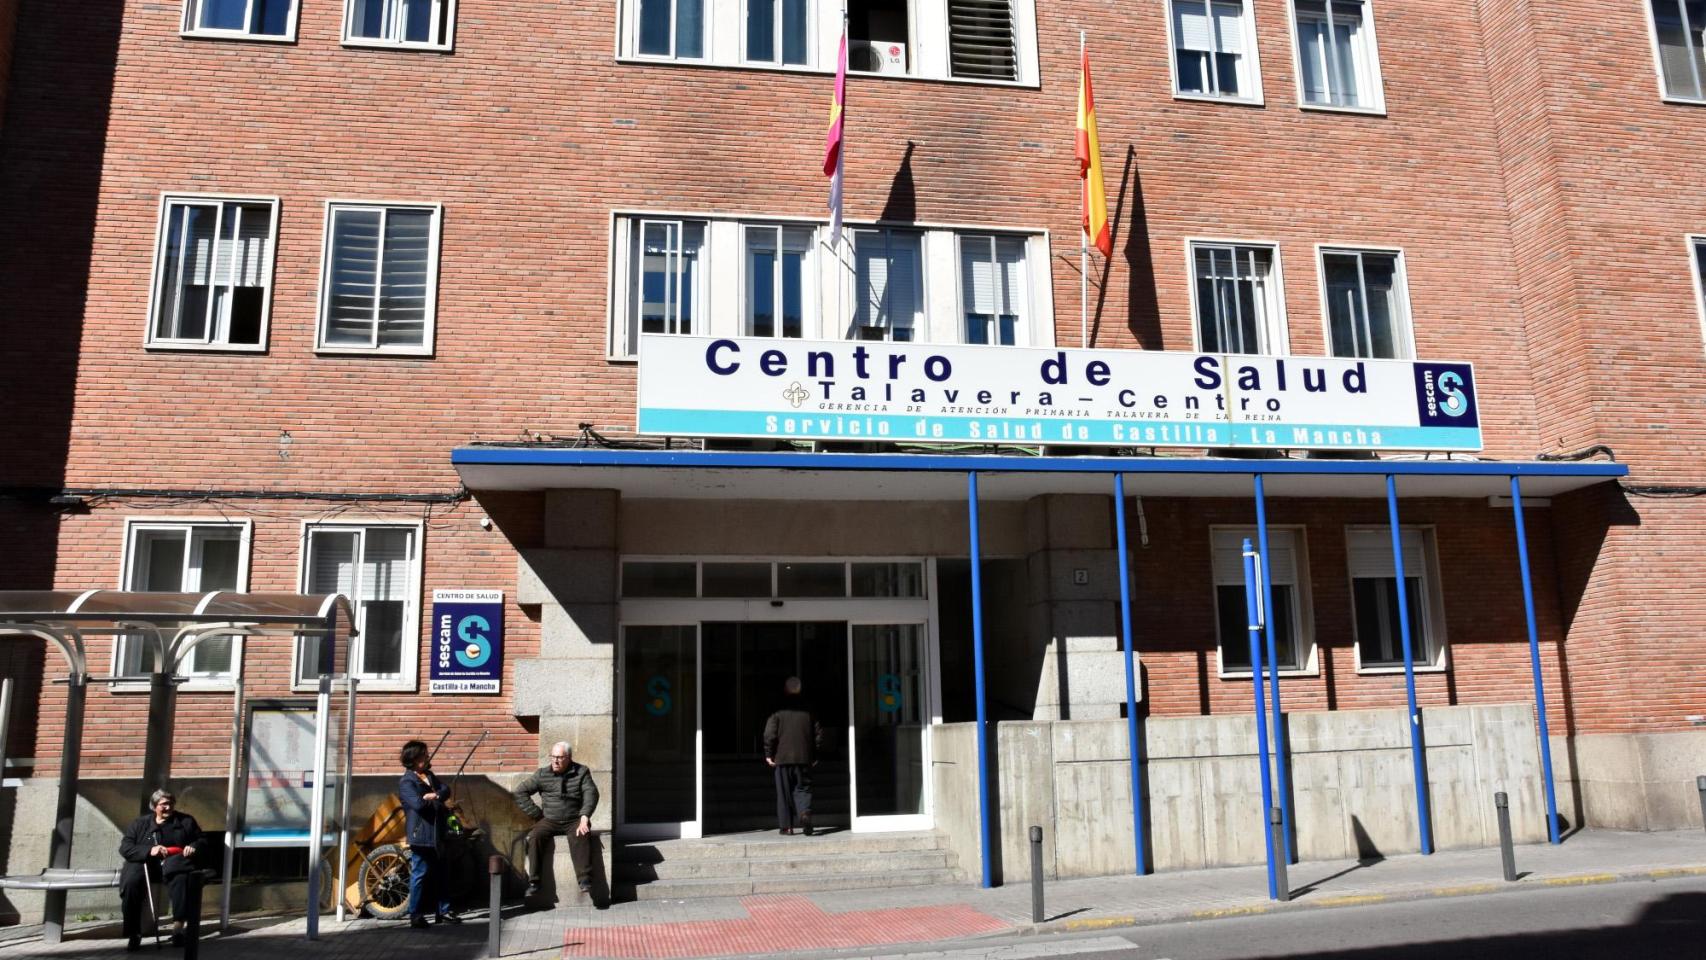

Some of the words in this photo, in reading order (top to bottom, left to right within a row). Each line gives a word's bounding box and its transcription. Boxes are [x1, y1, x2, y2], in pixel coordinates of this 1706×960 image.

[705, 339, 953, 382] Centro
[1041, 351, 1111, 386] de
[1194, 355, 1368, 394] Salud
[818, 381, 1053, 407] Talavera
[1118, 390, 1282, 413] Centro
[1423, 370, 1438, 417] sescam
[818, 402, 889, 412] GERENCIA
[907, 405, 923, 414] DE
[940, 404, 1009, 415] ATENCIÓN
[1025, 408, 1092, 417] PRIMARIA
[1106, 410, 1171, 419] TALAVERA
[1185, 412, 1201, 420] DE
[1215, 413, 1230, 421] LA
[1244, 414, 1283, 422] REINA
[766, 414, 890, 435] Servicio
[915, 416, 944, 438] de
[969, 418, 1042, 439] Salud
[1062, 420, 1089, 440] de
[1112, 422, 1217, 443] Castilla
[1250, 426, 1276, 445] La
[1293, 426, 1383, 446] Mancha
[1078, 571, 1085, 581] 2
[438, 614, 452, 668] sescam
[469, 683, 496, 691] Mancha
